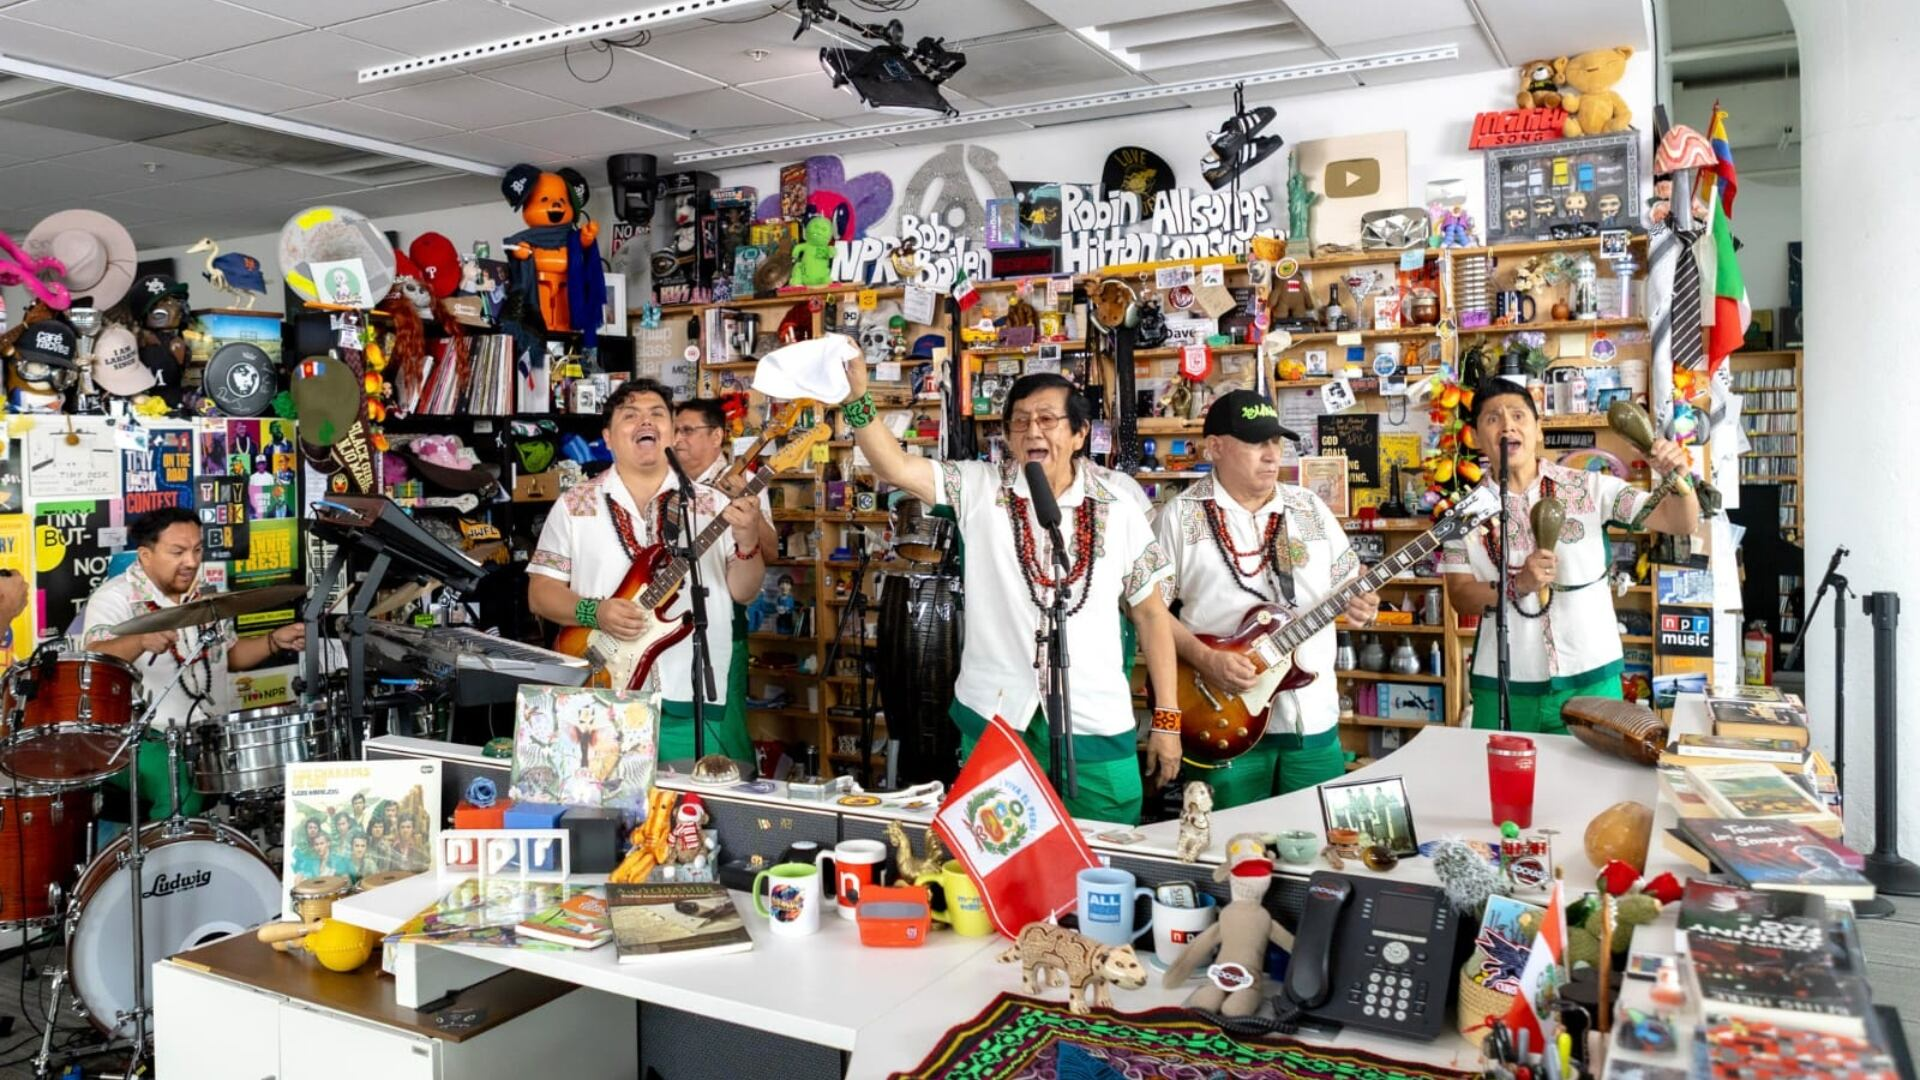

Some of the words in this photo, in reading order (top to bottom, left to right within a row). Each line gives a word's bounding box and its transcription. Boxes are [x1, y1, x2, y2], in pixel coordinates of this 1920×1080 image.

[1495, 133, 1545, 145] SONG
[1114, 150, 1147, 167] LOVE
[1061, 183, 1141, 233] Robin
[1151, 184, 1272, 242] Allsongs
[614, 225, 633, 239] NO
[902, 212, 949, 252] Bob
[830, 236, 902, 284] NPR
[1060, 226, 1160, 274] Hilton
[1321, 436, 1339, 446] GOD
[176, 453, 191, 468] THE
[166, 467, 188, 482] ROAD
[126, 491, 178, 513] CONTEST
[201, 482, 243, 503] TINY
[44, 507, 91, 527] TINY
[44, 527, 92, 547] BUT-
[235, 551, 291, 573] FRESH
[1665, 617, 1706, 632] npr
[1662, 631, 1709, 647] music
[445, 839, 554, 876] npr
[141, 869, 213, 899] Ludwig
[1089, 895, 1119, 906] ALL
